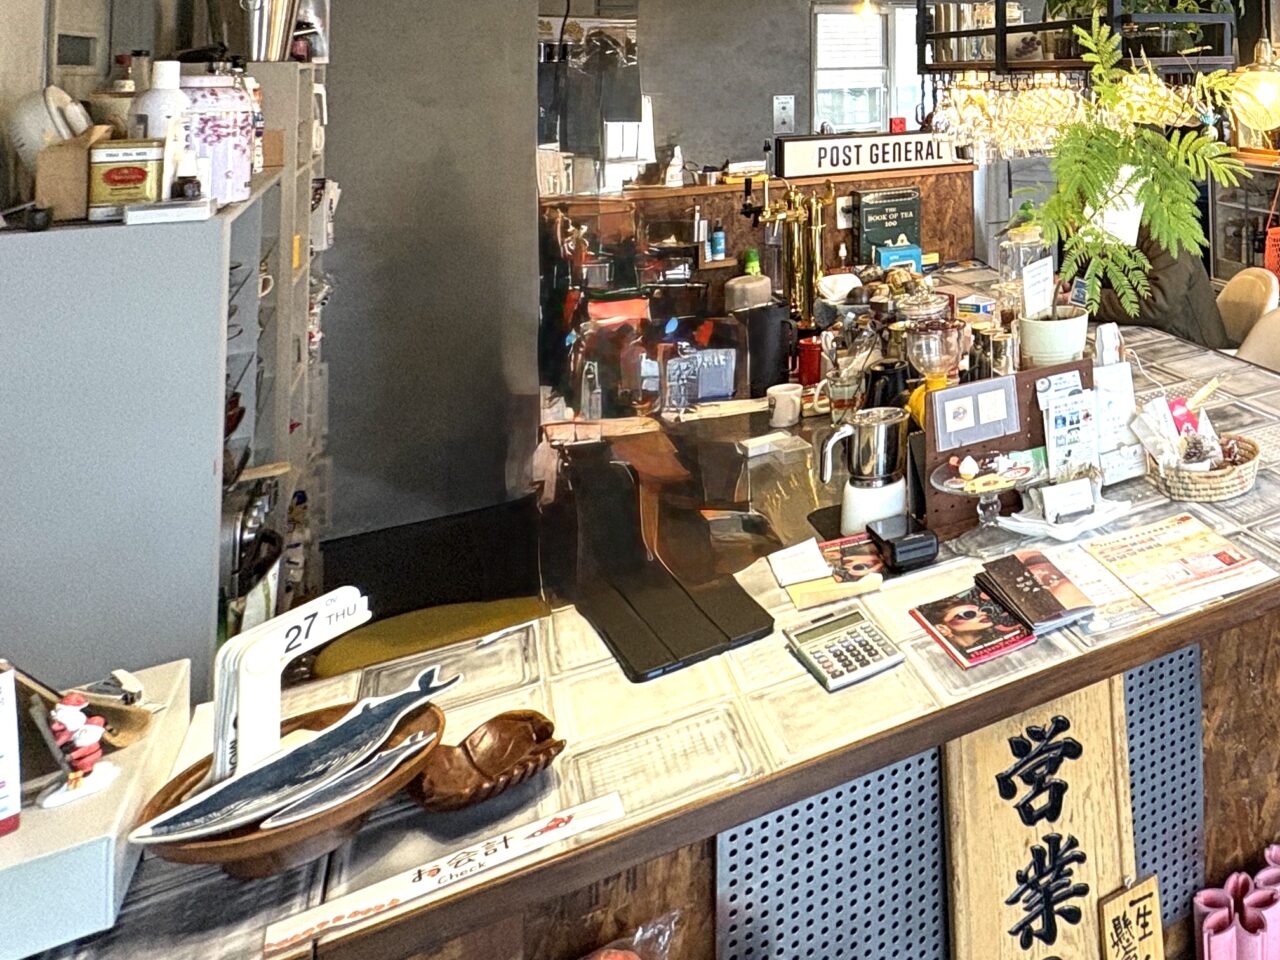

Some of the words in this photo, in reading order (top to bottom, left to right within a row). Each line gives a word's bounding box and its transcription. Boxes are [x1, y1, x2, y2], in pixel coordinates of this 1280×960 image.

[818, 144, 863, 168] POST
[869, 140, 943, 165] GENERAL
[867, 213, 887, 222] BOOK
[888, 213, 899, 221] OF
[284, 611, 319, 654] 27
[325, 603, 357, 626] THU
[411, 834, 515, 883] お会計
[995, 713, 1090, 960] 営業
[437, 860, 487, 885] Check
[1128, 891, 1154, 960] 一生
